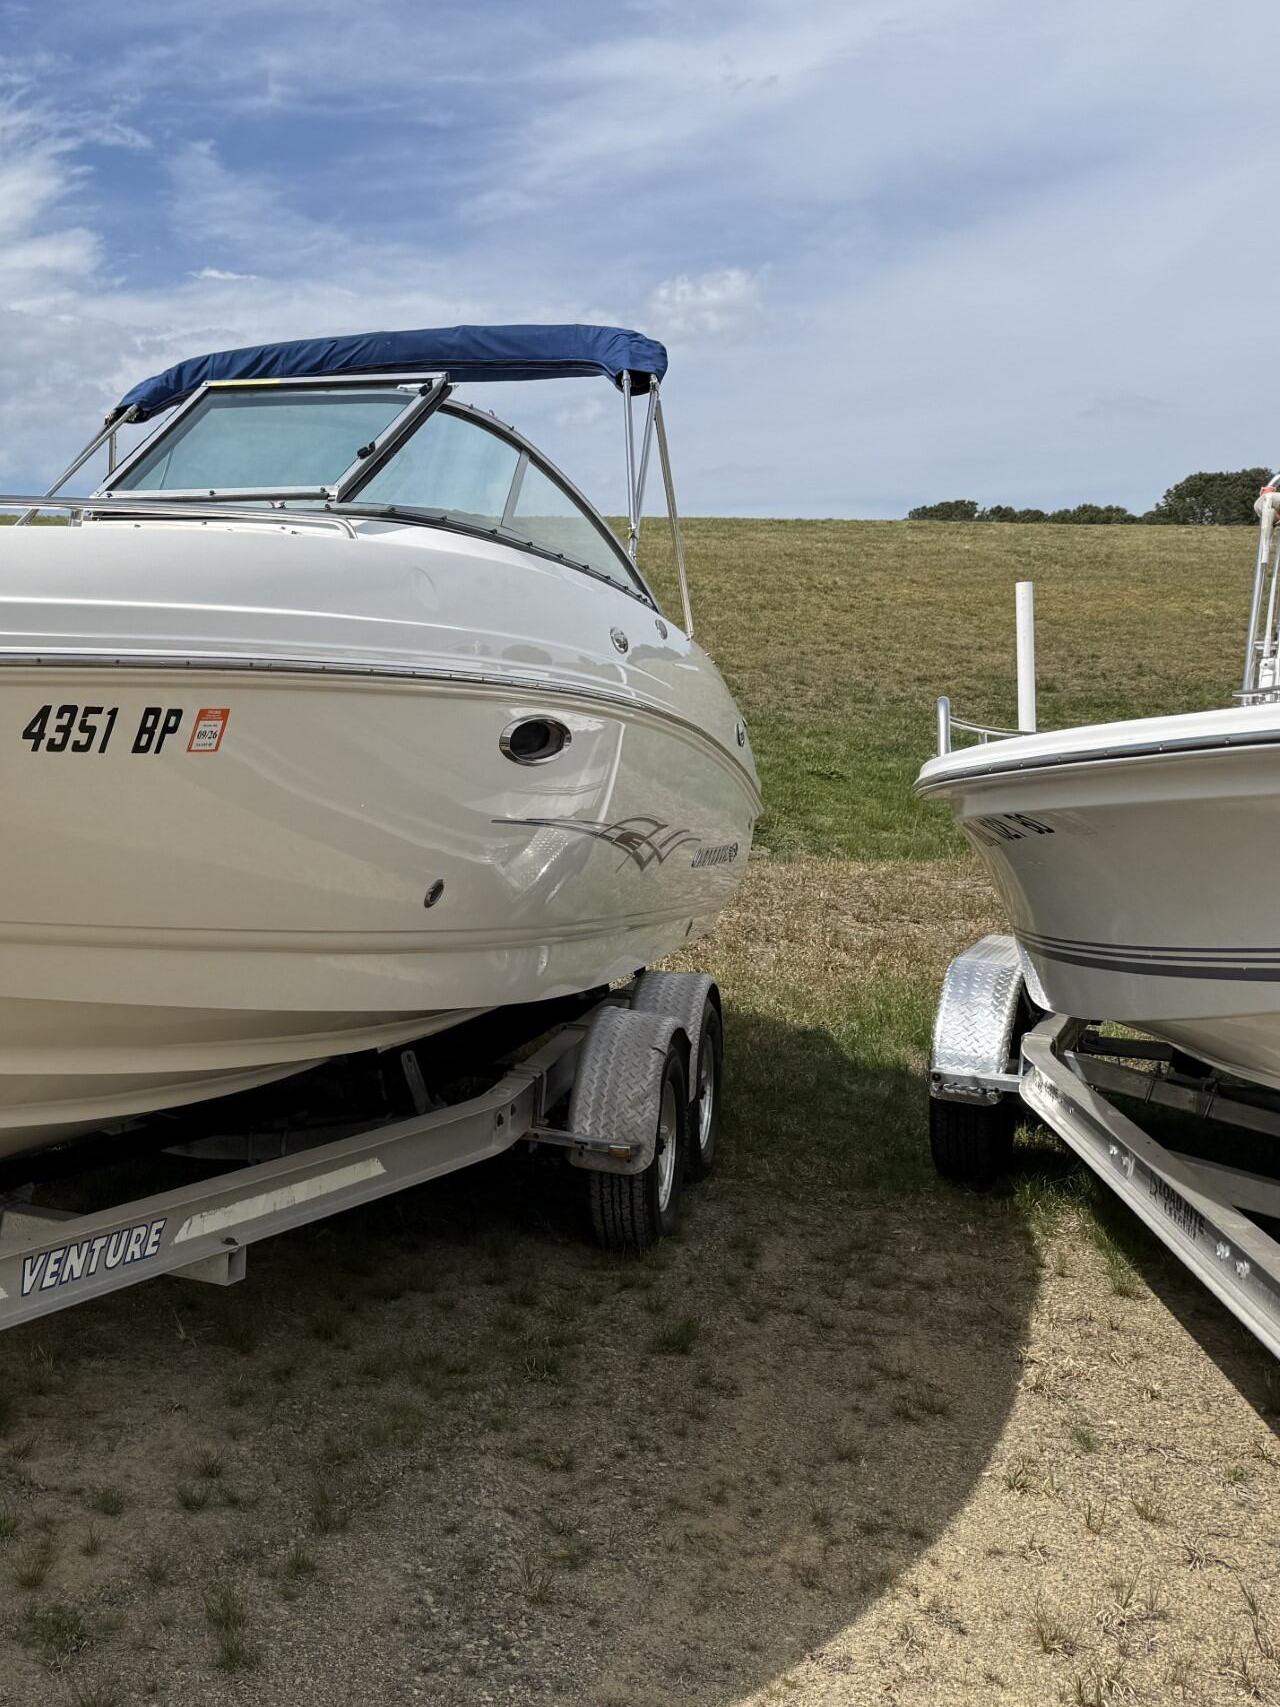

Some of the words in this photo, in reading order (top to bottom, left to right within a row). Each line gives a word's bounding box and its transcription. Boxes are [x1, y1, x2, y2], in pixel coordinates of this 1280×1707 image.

[22, 705, 119, 753] 4351
[131, 707, 183, 754] BP
[197, 730, 218, 740] 09/26
[22, 1219, 166, 1295] VENTURE
